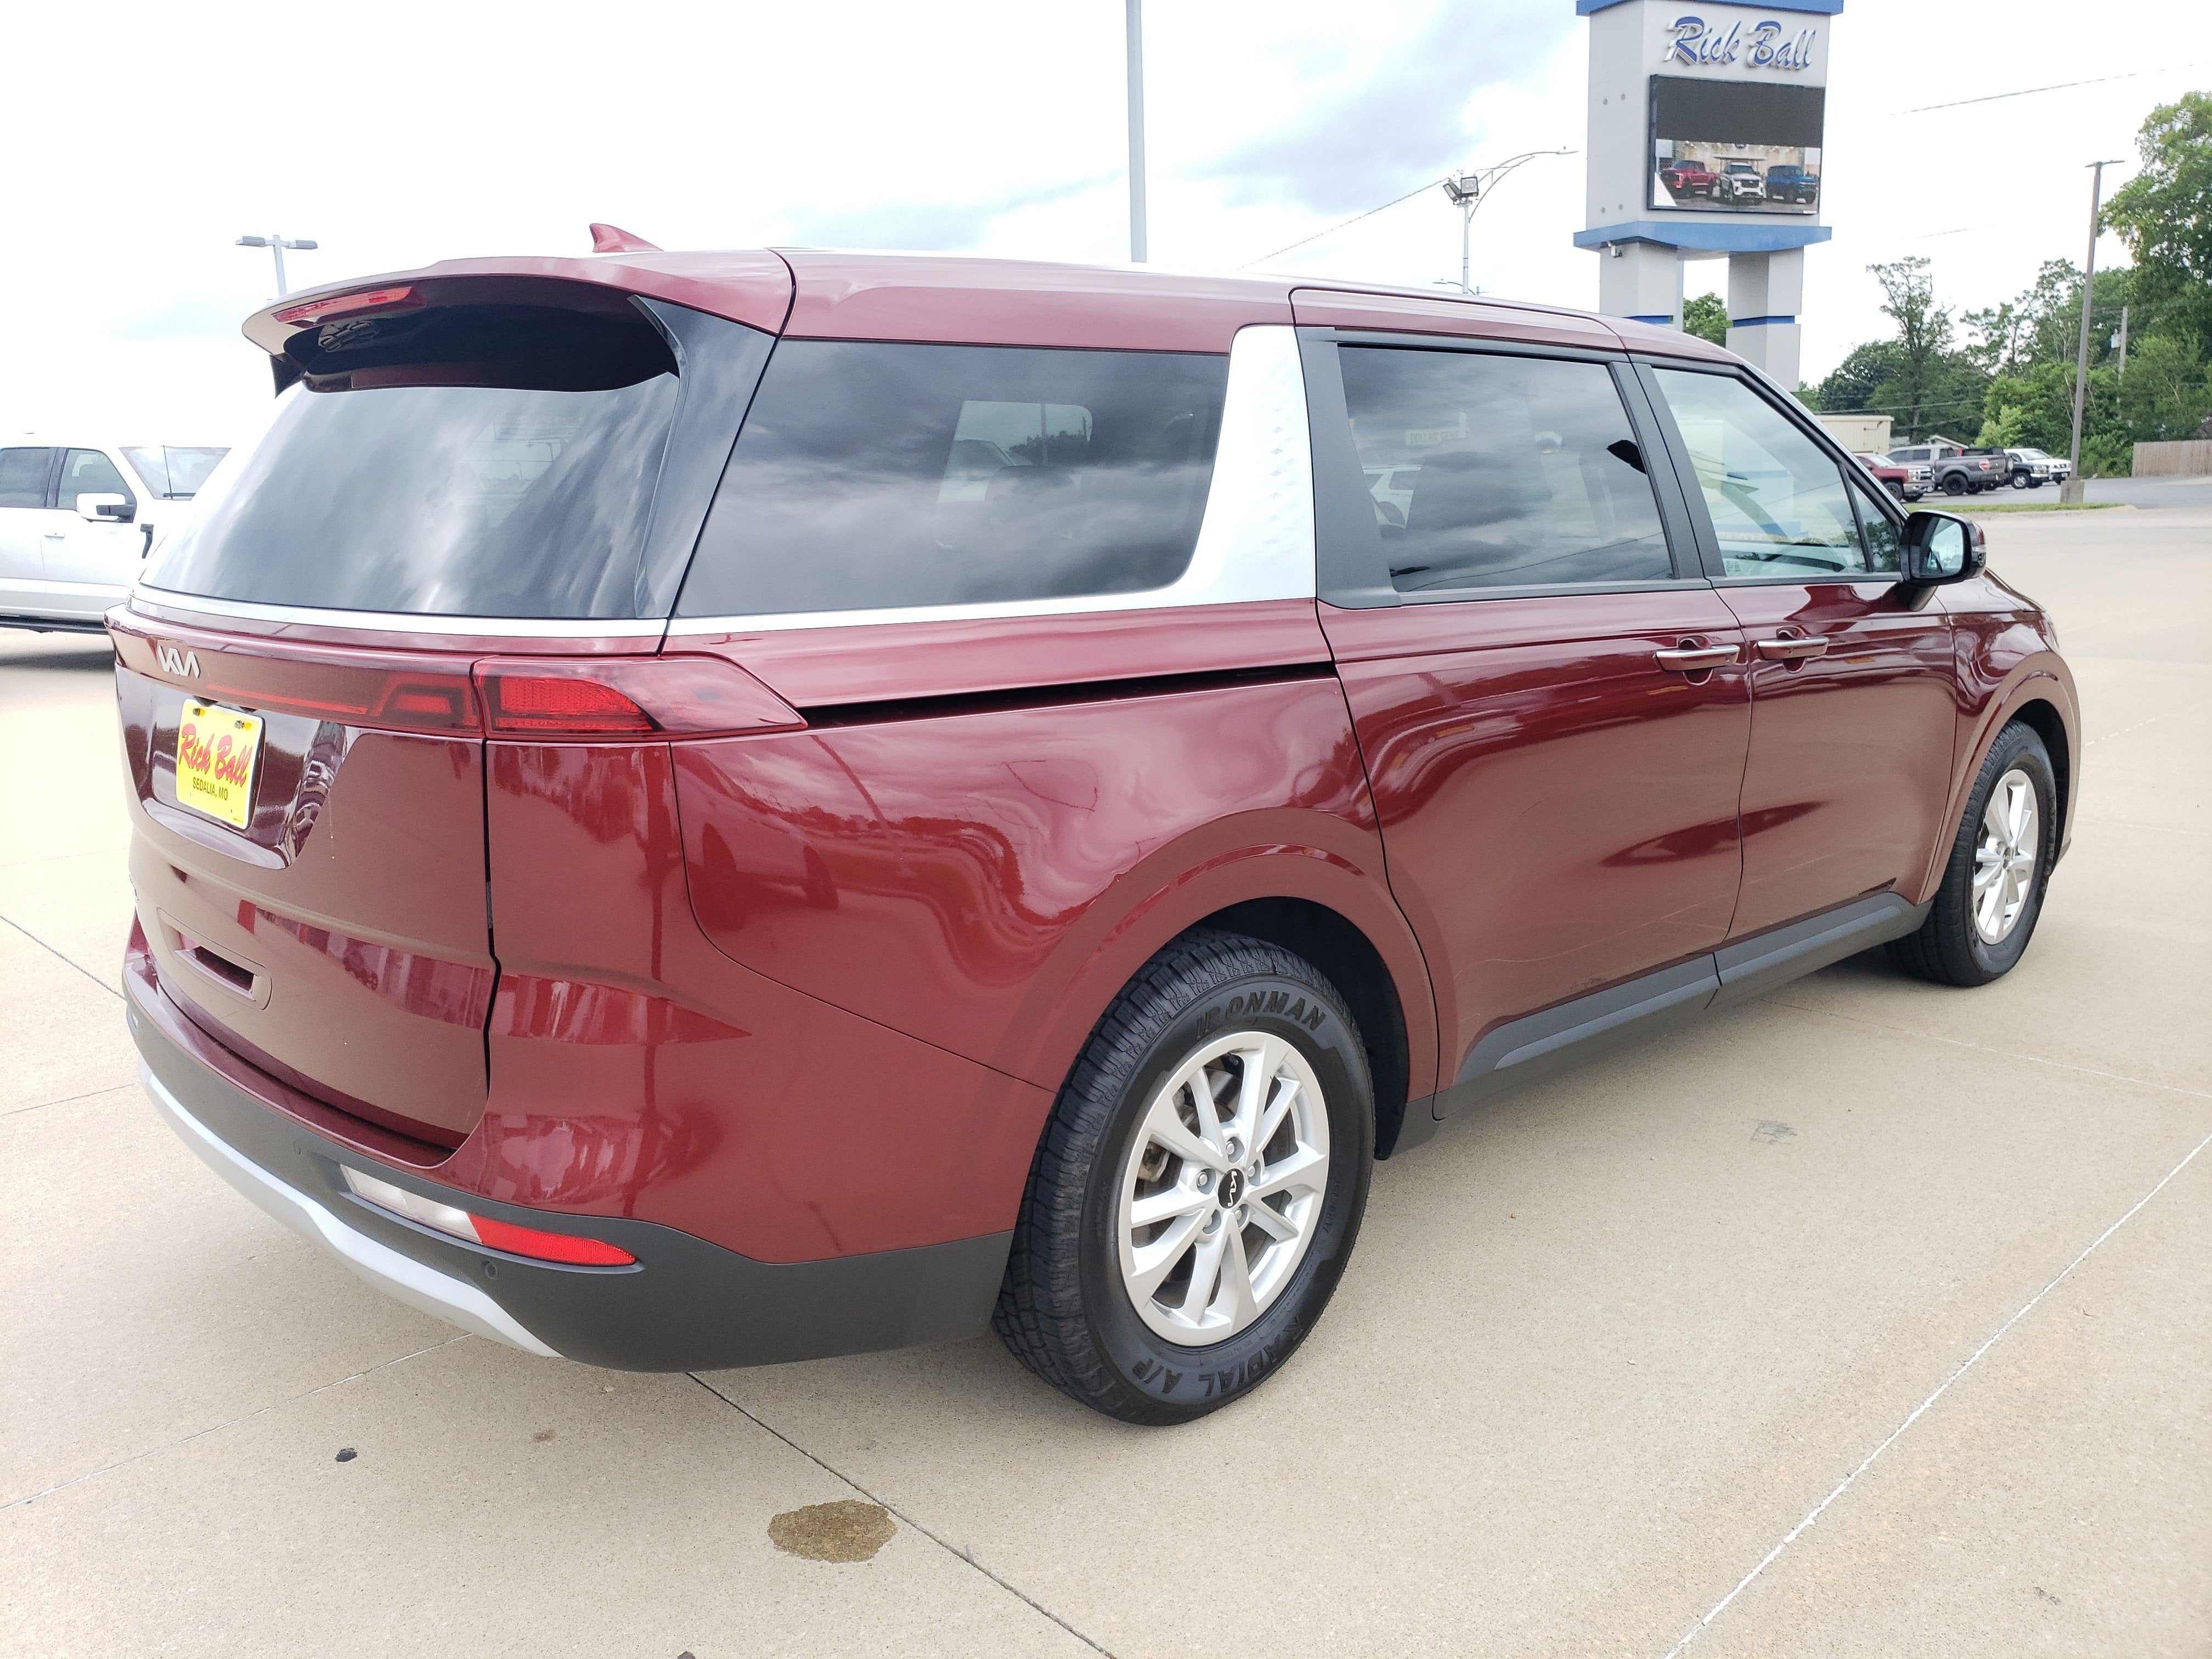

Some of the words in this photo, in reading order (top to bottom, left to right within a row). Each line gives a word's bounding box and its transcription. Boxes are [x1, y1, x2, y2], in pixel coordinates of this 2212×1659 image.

[1664, 16, 1742, 65] Rick
[1747, 21, 1817, 70] Ball
[158, 645, 201, 679] KIA
[178, 723, 214, 775] Rick
[215, 735, 253, 787] Ball
[218, 786, 229, 801] MO
[1196, 990, 1327, 1040] IRONMAN
[1132, 1358, 1183, 1395] A/P
[1198, 1315, 1304, 1397] RADIAL
